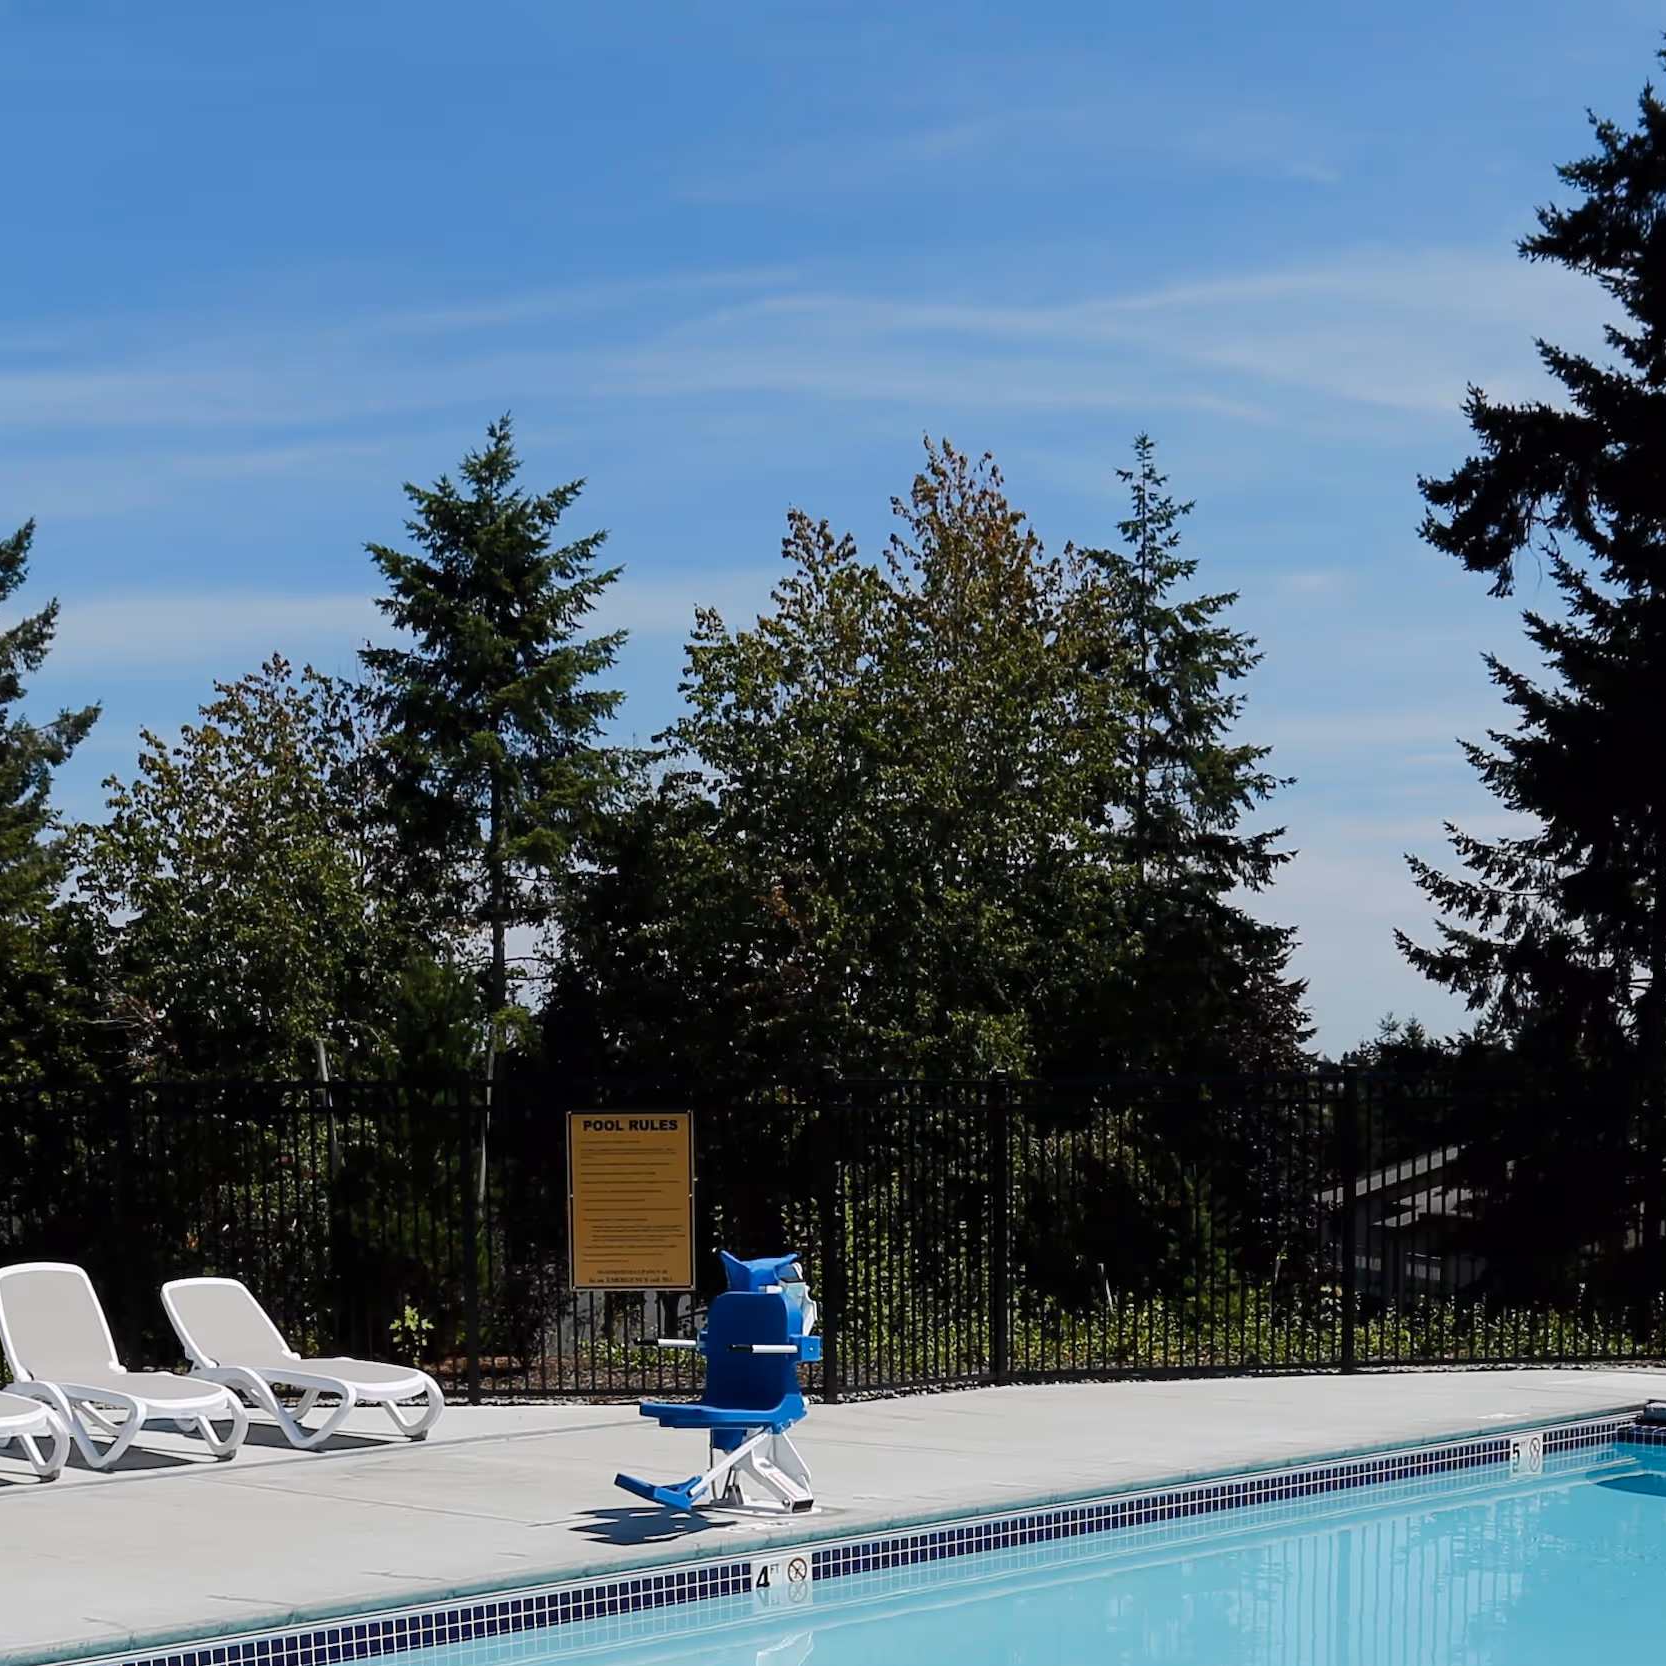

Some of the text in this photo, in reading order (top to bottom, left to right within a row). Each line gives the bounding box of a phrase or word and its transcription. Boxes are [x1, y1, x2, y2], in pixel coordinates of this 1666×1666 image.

[582, 1119, 679, 1131] POOL RULES
[756, 1565, 770, 1588] 4
